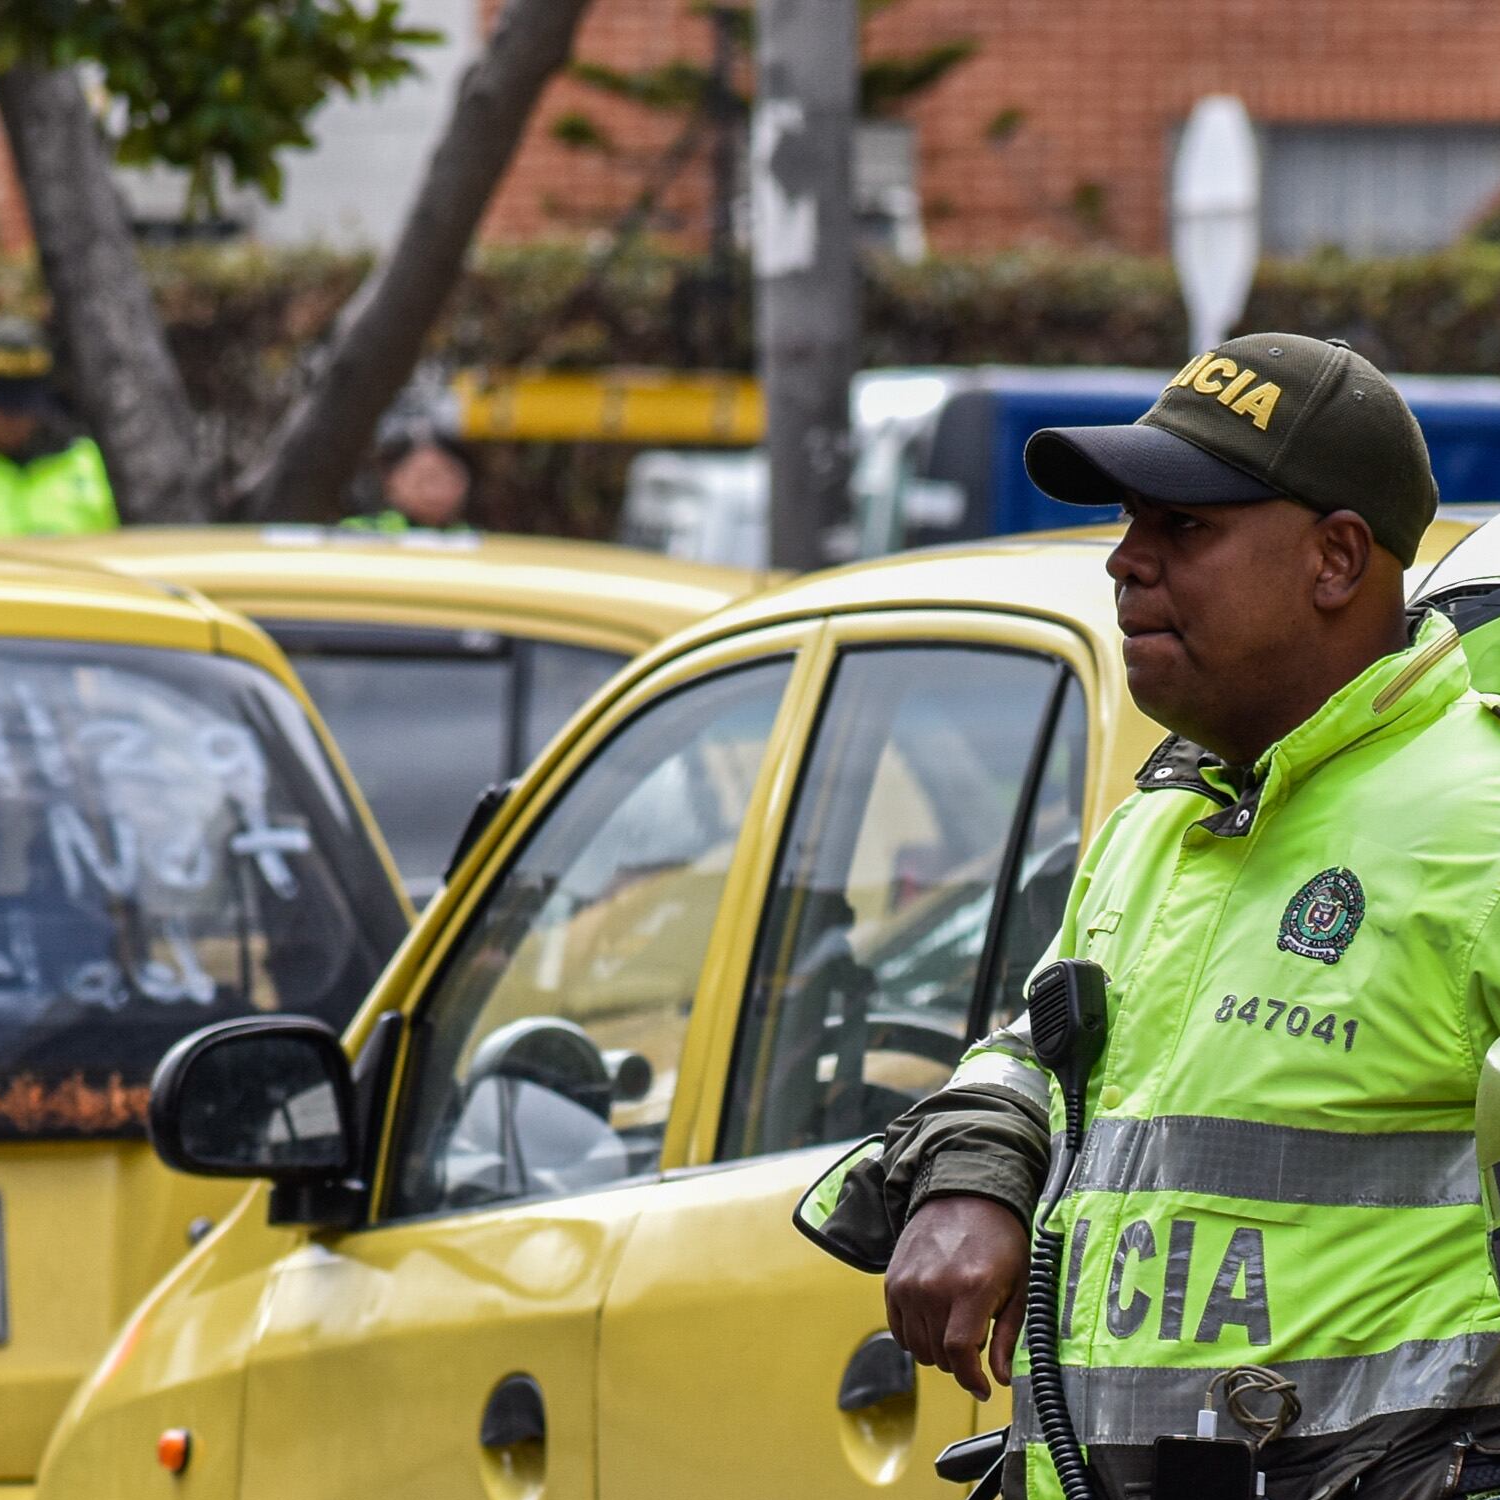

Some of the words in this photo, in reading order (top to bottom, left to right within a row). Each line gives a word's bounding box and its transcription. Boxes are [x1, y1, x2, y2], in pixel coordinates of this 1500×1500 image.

[1164, 352, 1282, 431] ICIA
[1214, 994, 1359, 1052] 847041
[1022, 1218, 1272, 1346] ICIA
